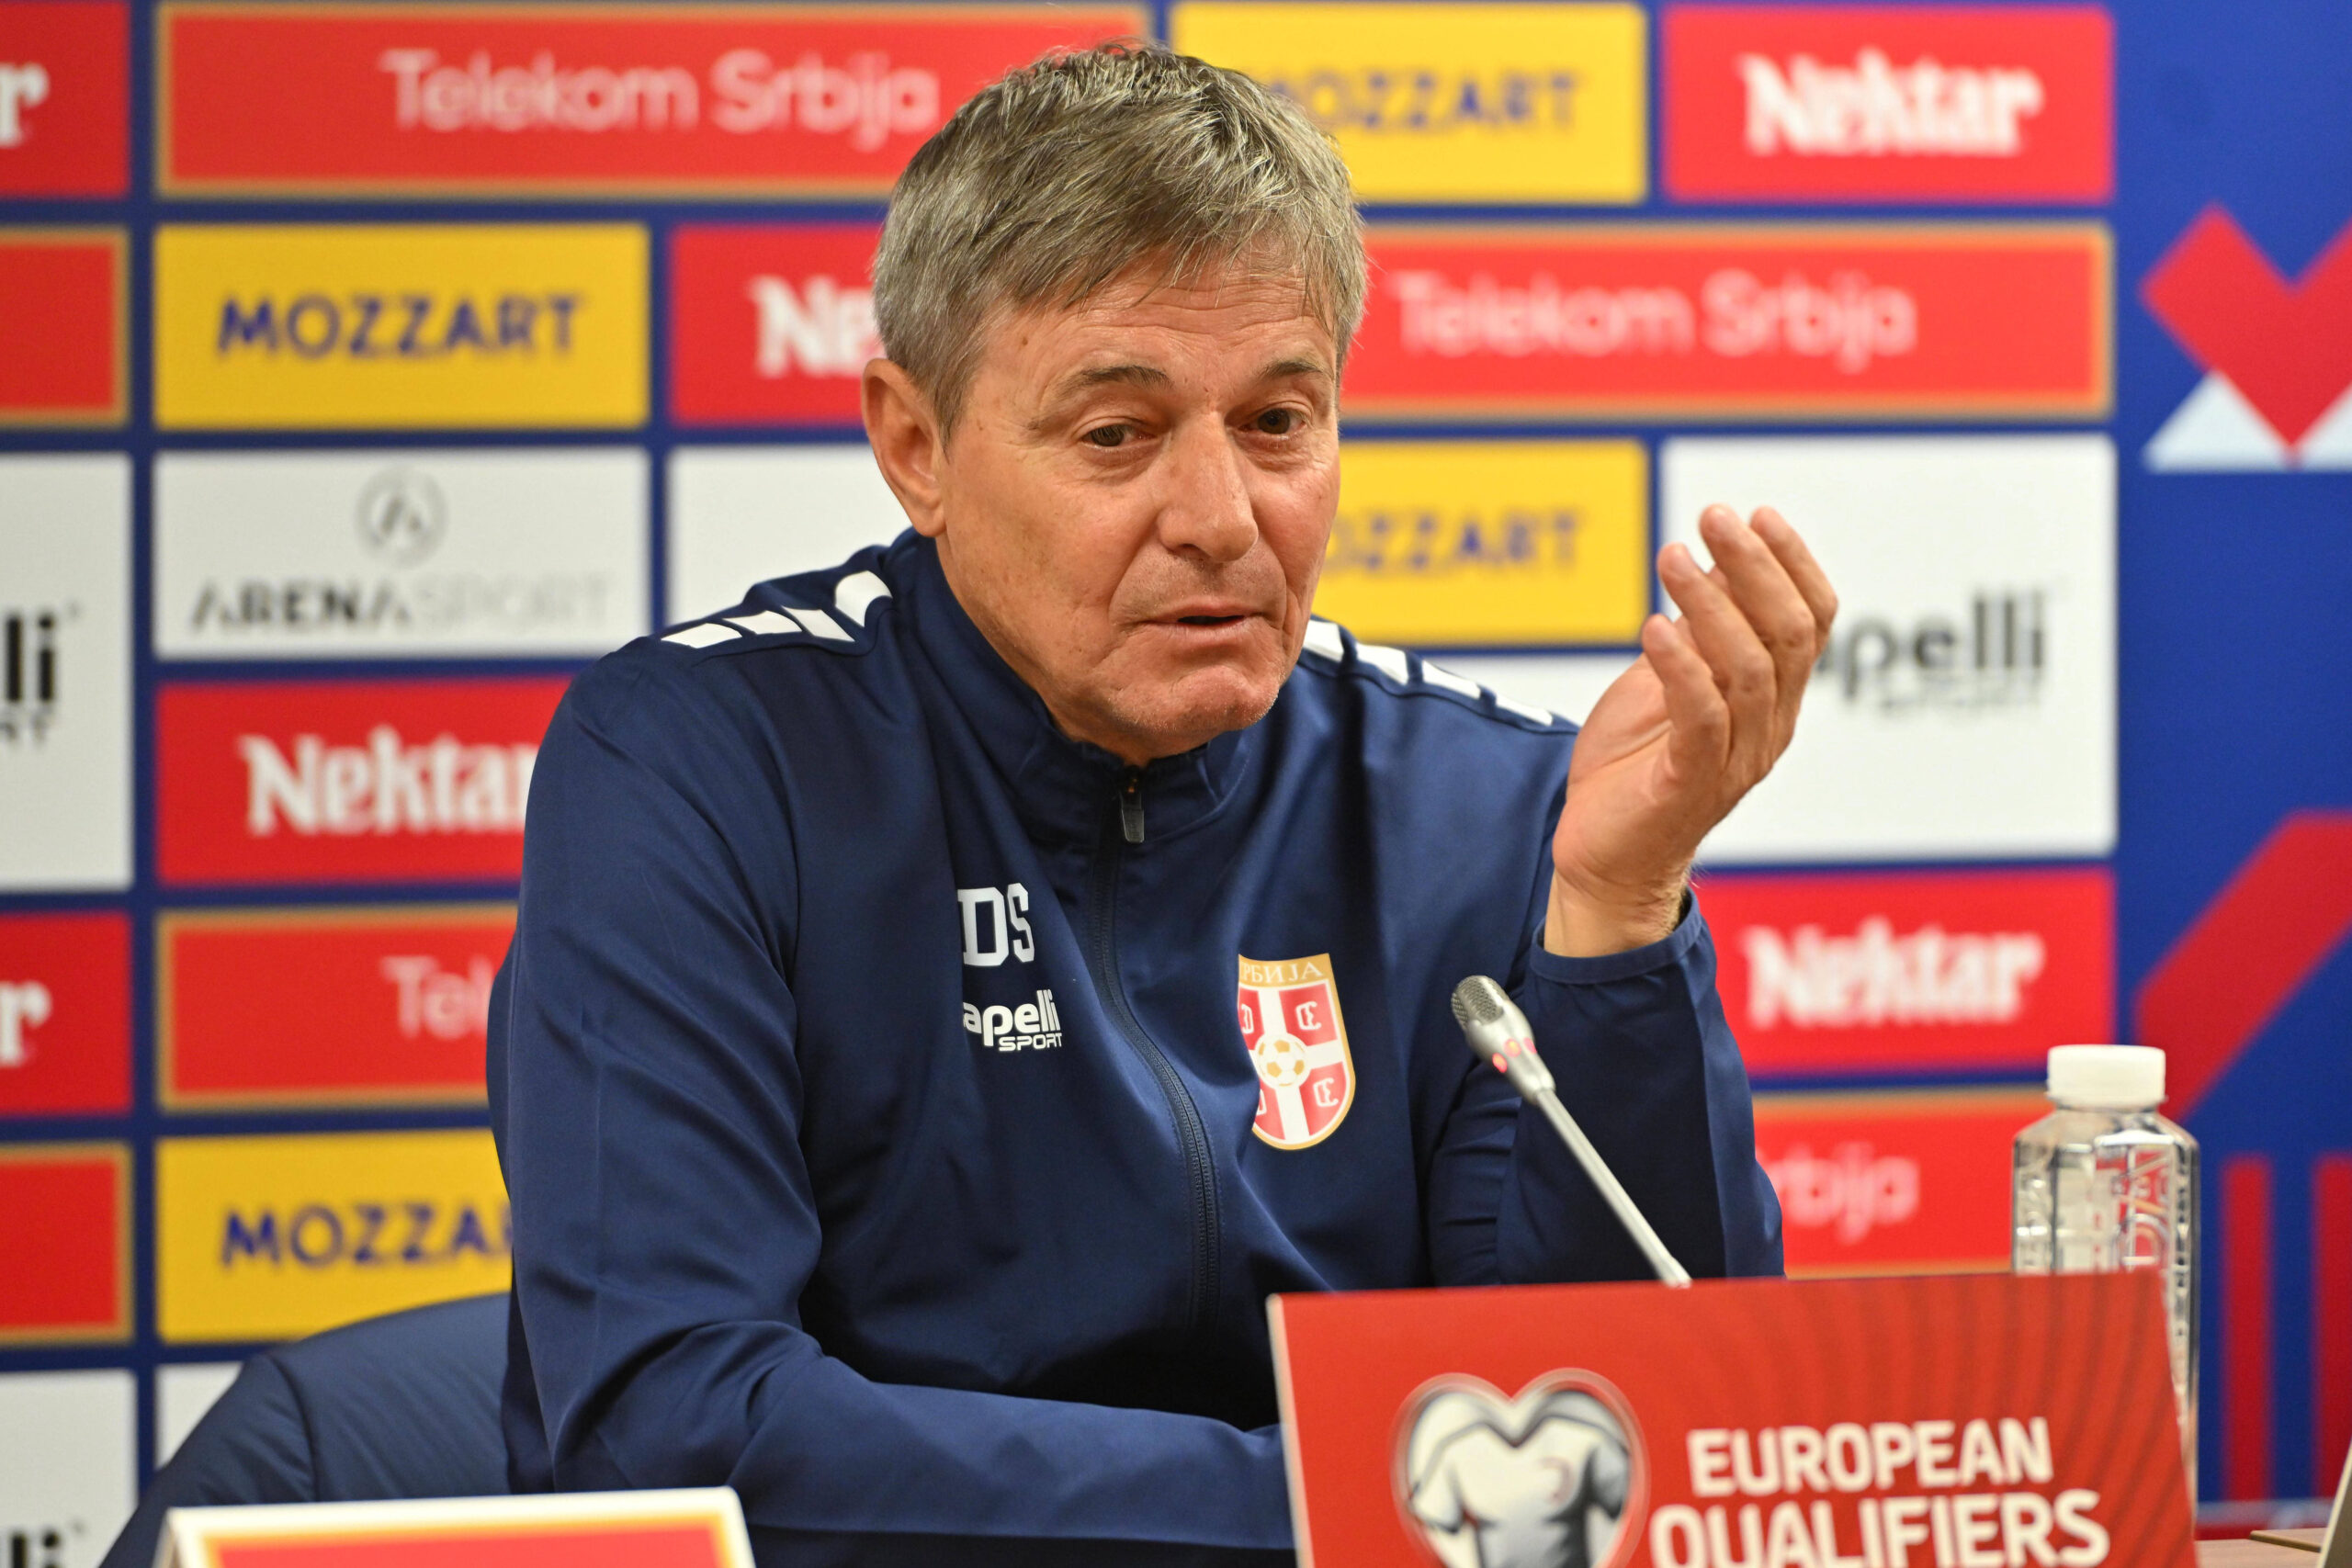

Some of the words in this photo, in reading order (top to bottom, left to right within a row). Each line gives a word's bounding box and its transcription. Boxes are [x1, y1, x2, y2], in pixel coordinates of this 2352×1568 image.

[379, 48, 699, 131] Telekom
[712, 49, 940, 152] Srbija
[1272, 70, 1579, 134] OZZART
[1739, 49, 2043, 156] Nektar
[215, 292, 581, 360] MOZZART
[1387, 270, 1695, 356] Telekom
[1701, 268, 1917, 373] Srbija
[1321, 508, 1580, 579] ZZART
[189, 580, 411, 632] ARENA
[957, 883, 1035, 966] DS
[1240, 961, 1324, 984] РБИЈА
[1742, 919, 2045, 1031] Nektar
[963, 989, 1061, 1047] apelli
[999, 1032, 1062, 1052] SPORT
[220, 1201, 512, 1270] MOZZA
[1686, 1416, 2054, 1498] EUROPEAN
[1648, 1488, 2110, 1568] QUALIFIERS
